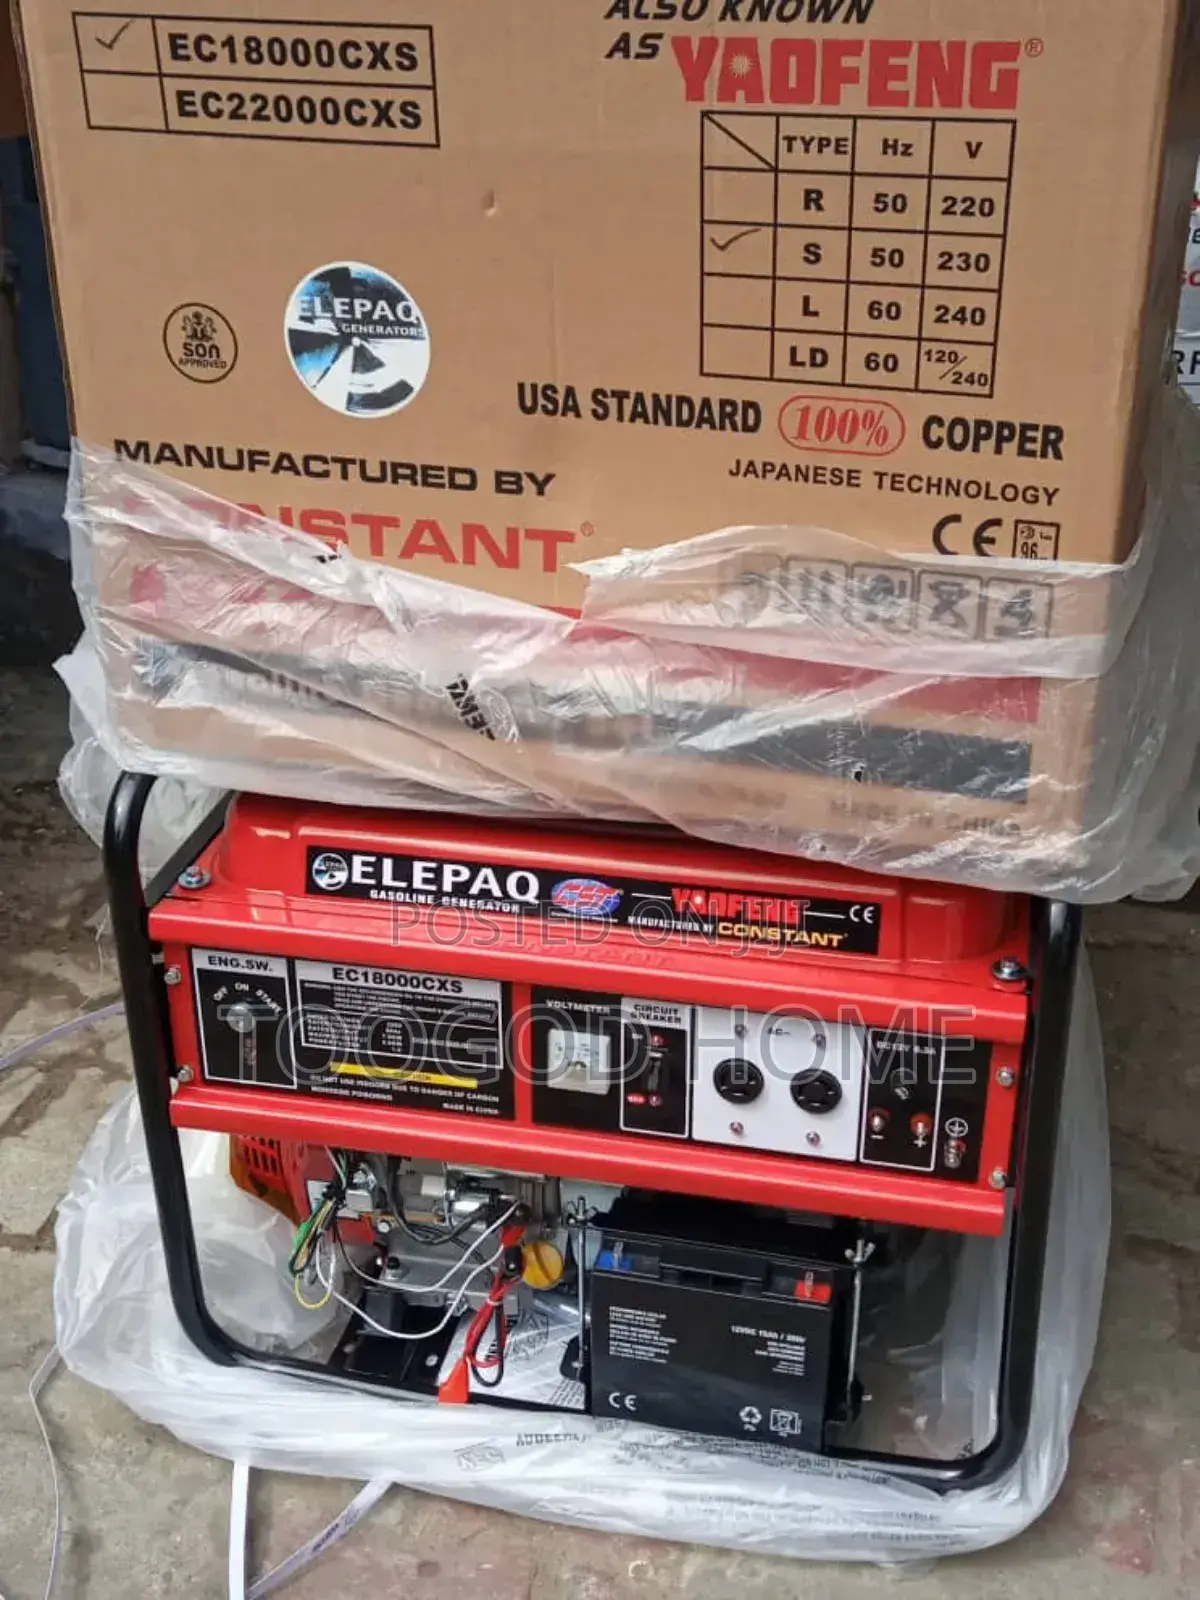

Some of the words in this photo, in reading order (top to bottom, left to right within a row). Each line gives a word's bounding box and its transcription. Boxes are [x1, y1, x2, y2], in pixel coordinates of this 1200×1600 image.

[604, 0, 710, 22] ALSO
[717, 0, 876, 25] KNOWN
[167, 32, 419, 72] EC18000CXS
[605, 31, 664, 60] AS
[670, 36, 1021, 110] YAOFENG
[176, 90, 424, 130] EC22000CXS
[783, 134, 849, 156] TYPE
[881, 138, 914, 157] Hz
[965, 141, 983, 160] V
[803, 188, 824, 212] R
[873, 192, 908, 214] 50
[940, 196, 996, 218] 220
[802, 243, 822, 266] S
[870, 248, 905, 270] 50
[937, 251, 991, 274] 230
[298, 295, 420, 324] ELEPAQ
[802, 296, 819, 318] L
[867, 300, 901, 322] 60
[933, 305, 986, 328] 240
[789, 347, 829, 370] LD
[864, 353, 899, 375] 60
[517, 381, 581, 420] USA
[590, 388, 762, 433] STANDARD
[790, 404, 891, 448] 100%
[922, 414, 1065, 461] COPPER
[113, 438, 478, 492] MANUFACTURED
[493, 470, 556, 497] BY
[728, 458, 862, 489] JAPANESE
[874, 470, 1061, 508] TECHNOLOGY
[351, 854, 540, 905] ELEPAQ
[370, 889, 435, 905] GASOLINE
[441, 896, 520, 913] GENERATOR
[717, 921, 846, 948] CONSTANT
[207, 954, 274, 972] ENG.SW.
[332, 966, 464, 994] EC18000CXS
[545, 998, 611, 1014] VOLTMETER
[633, 1003, 679, 1016] CIRCUIT
[608, 1391, 638, 1412] CE
